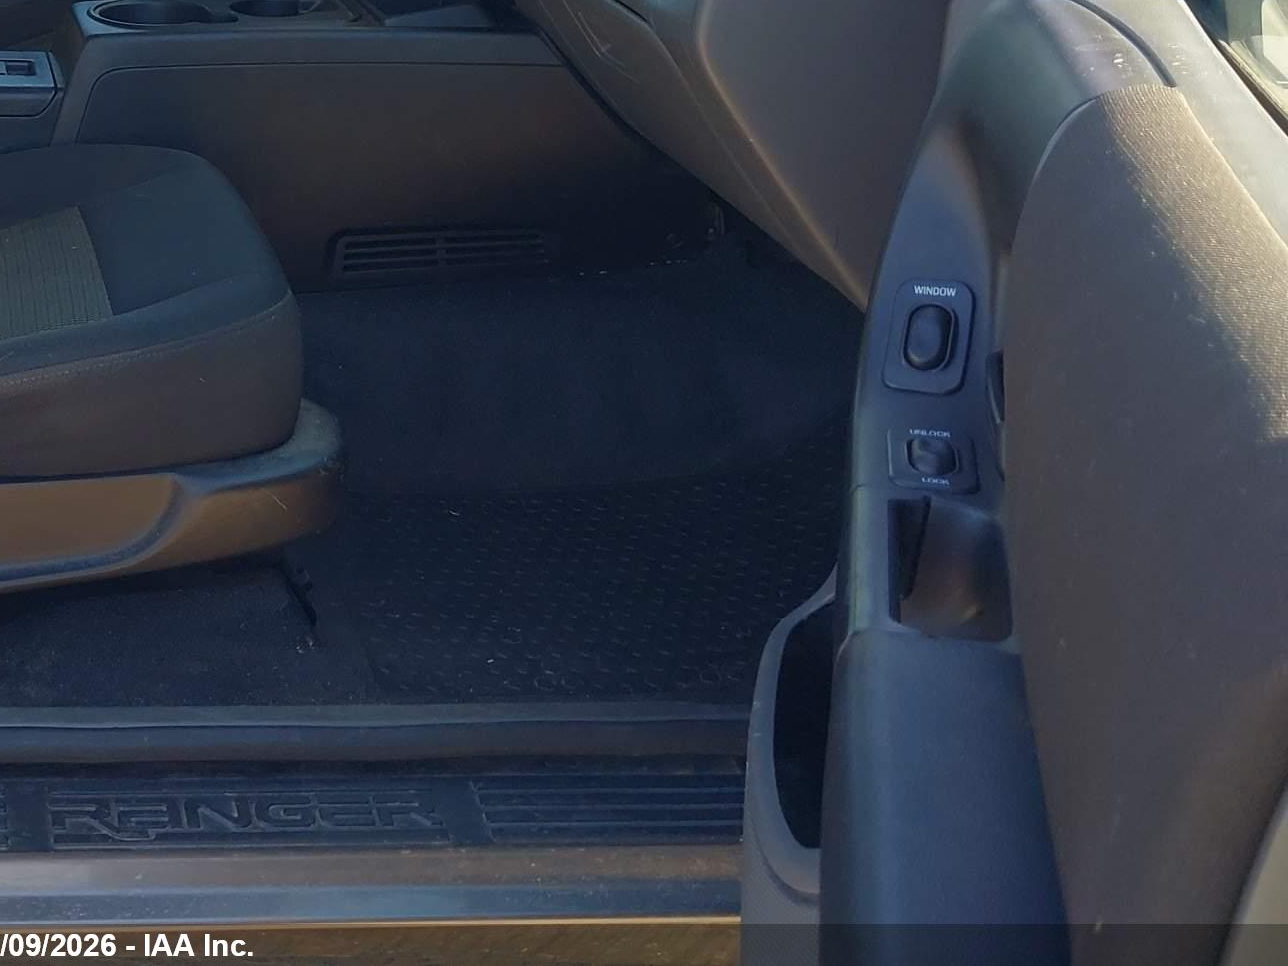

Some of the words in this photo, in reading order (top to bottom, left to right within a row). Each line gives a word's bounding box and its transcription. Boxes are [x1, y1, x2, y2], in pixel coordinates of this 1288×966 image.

[914, 285, 957, 297] WINDOW
[921, 477, 950, 486] LOCK
[48, 793, 447, 838] RANGER
